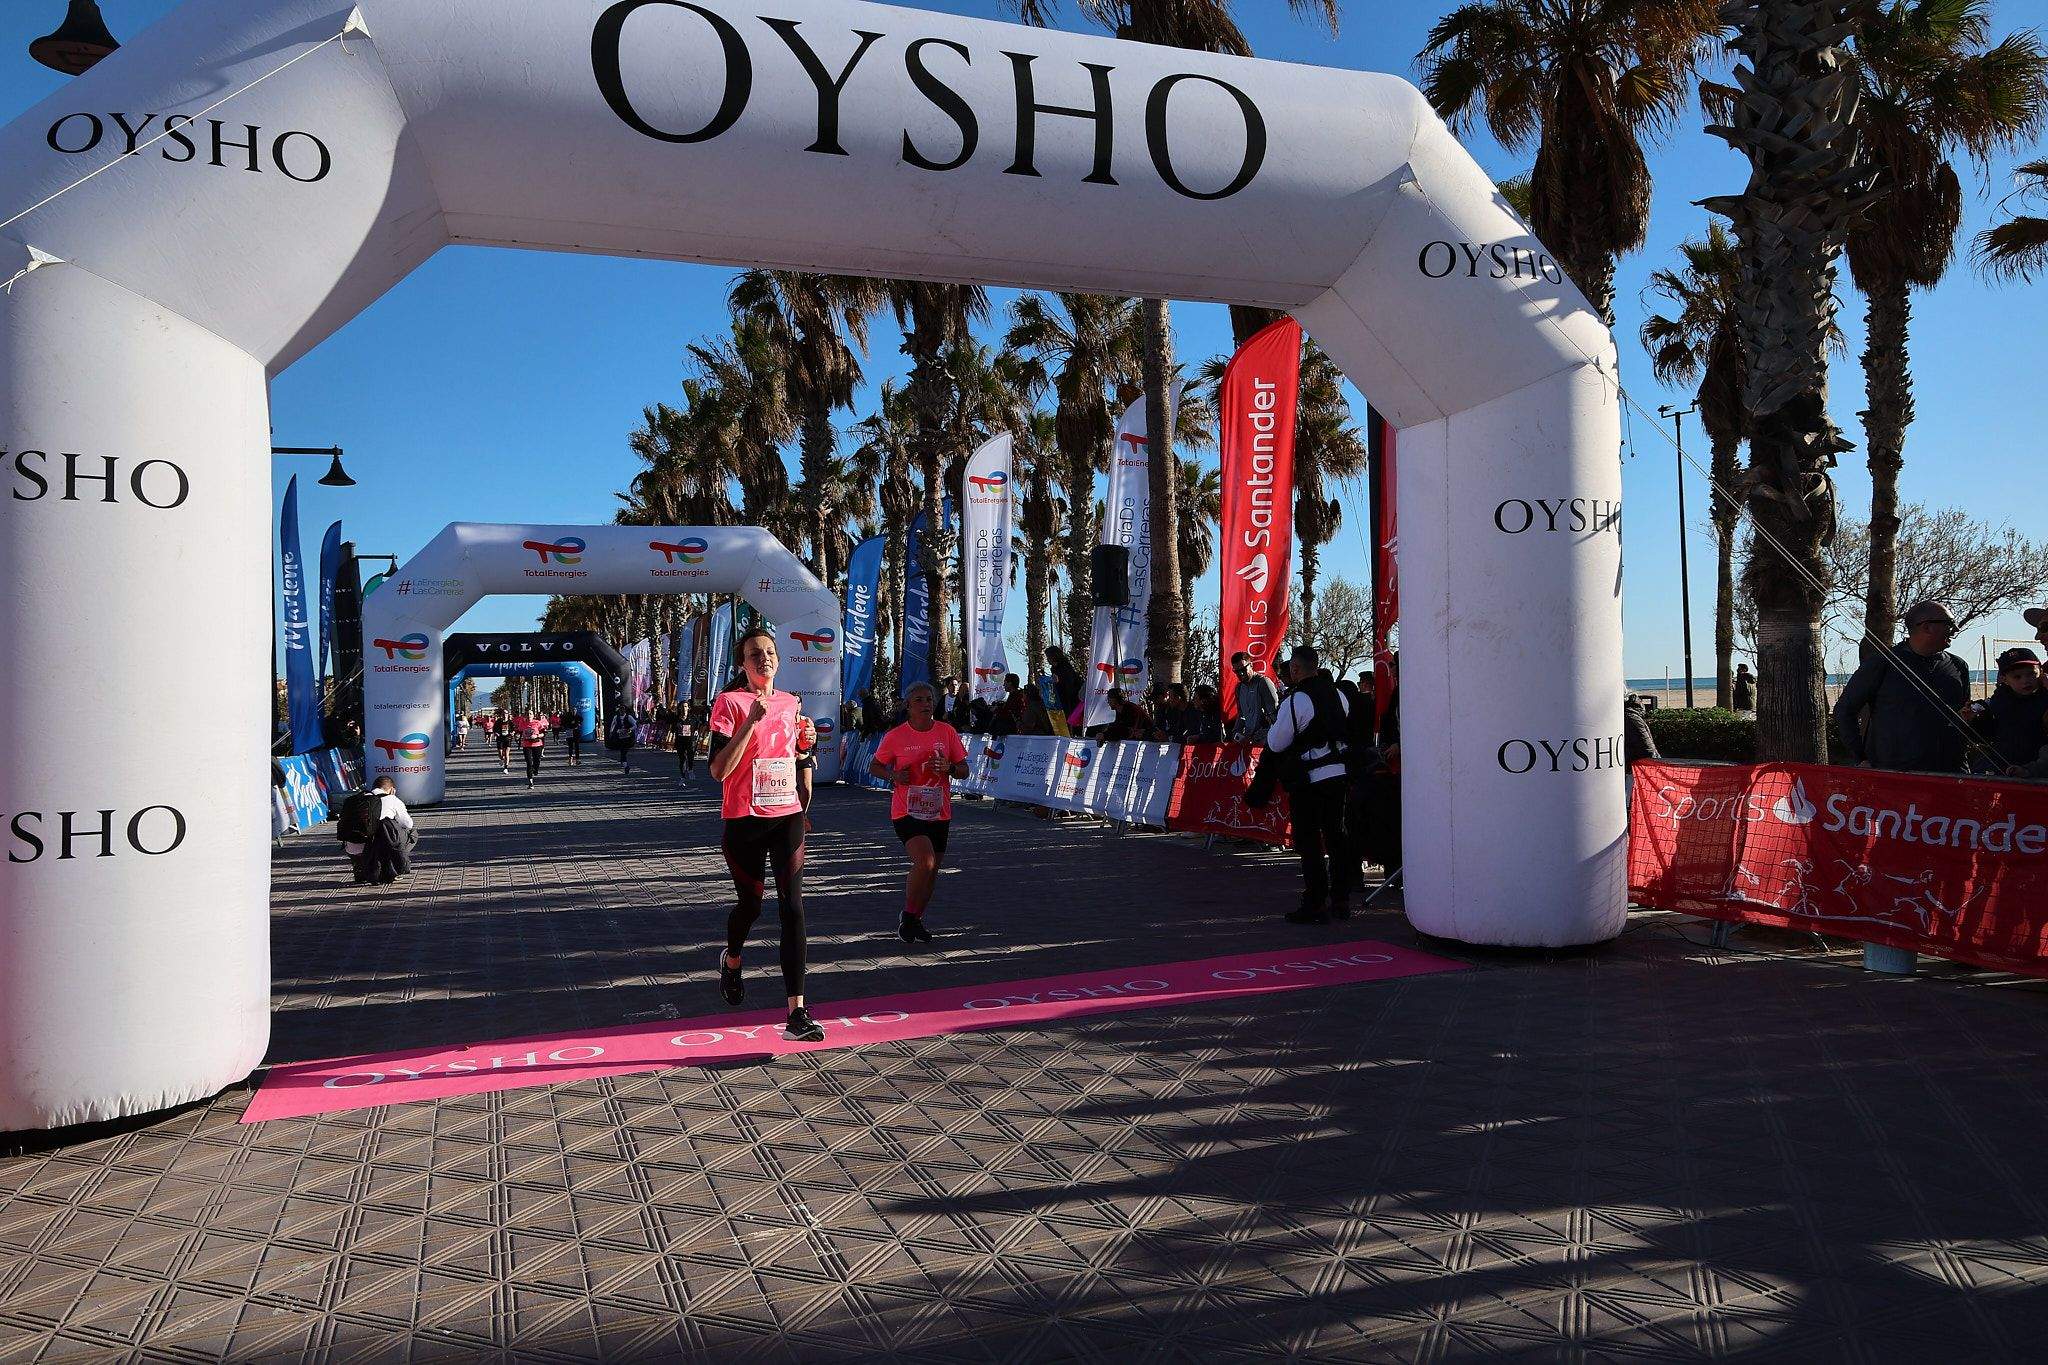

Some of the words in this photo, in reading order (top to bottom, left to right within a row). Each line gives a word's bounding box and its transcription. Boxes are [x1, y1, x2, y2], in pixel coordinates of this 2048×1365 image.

[590, 0, 1267, 201] OYSHO
[46, 112, 331, 182] OYSHO
[1418, 240, 1562, 285] OYSHO
[0, 450, 190, 509] SHO
[1245, 377, 1276, 548] Santander
[970, 497, 1009, 505] TotalEnergies
[523, 569, 588, 578] TotalEnergies
[650, 569, 709, 577] TotalEnergies
[989, 527, 1003, 611] LasCarreras
[845, 584, 874, 657] Marlene
[907, 577, 930, 644] Marle
[476, 642, 574, 652] VOLVO
[1244, 600, 1268, 673] ports
[373, 664, 430, 674] TotalEnergies
[790, 656, 835, 664] TotalEnergies
[374, 702, 430, 710] totalenergies.es
[375, 765, 431, 774] TotalEnergies
[1188, 757, 1229, 783] Sports
[1656, 785, 1766, 829] Sports
[0, 804, 187, 863] SHO
[1211, 952, 1394, 983] OYSHO
[962, 979, 1170, 1010] OYSHO
[322, 1046, 605, 1090] OYSHO
